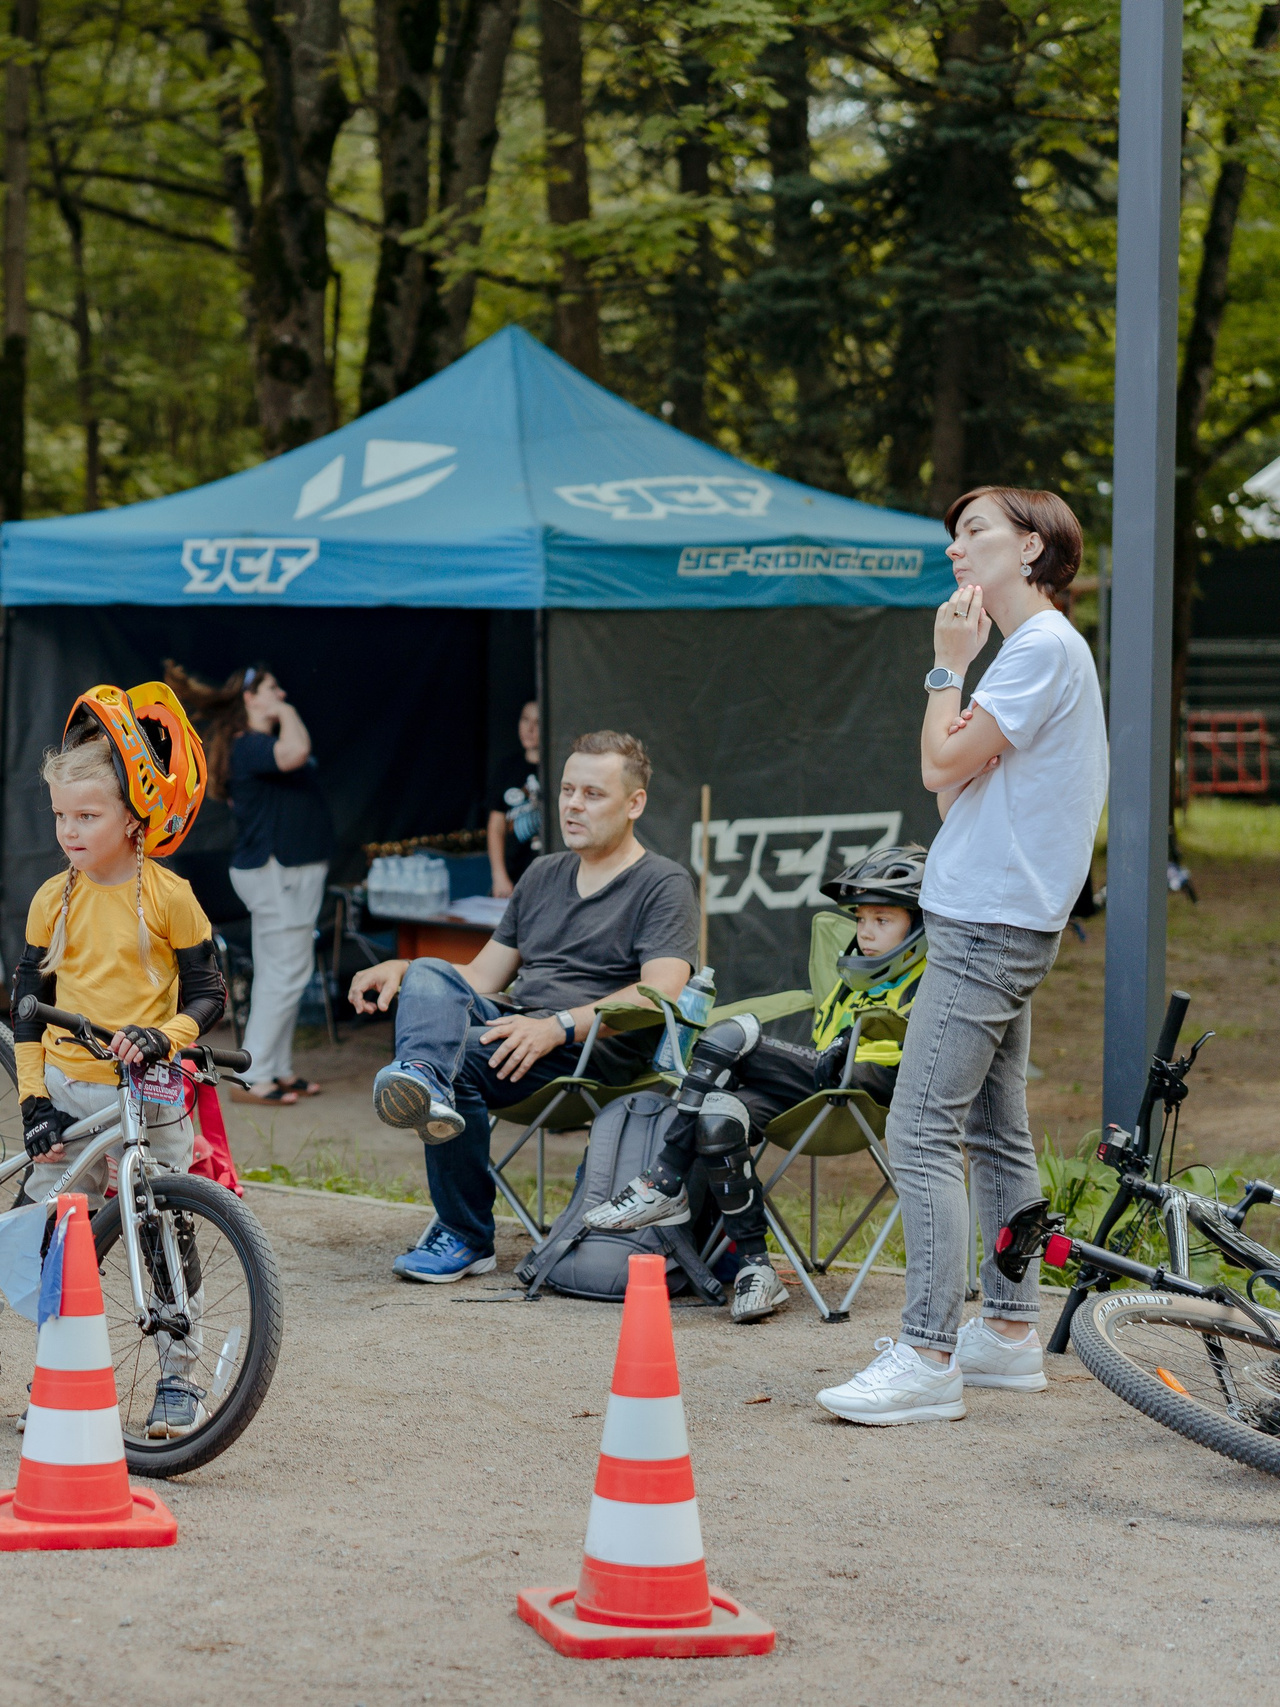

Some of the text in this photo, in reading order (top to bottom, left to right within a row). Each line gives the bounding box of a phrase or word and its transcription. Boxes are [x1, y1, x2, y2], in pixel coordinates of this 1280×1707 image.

[554, 475, 773, 520] YCF
[180, 538, 320, 593] YCF
[677, 546, 923, 578] YCF-RIDING.COM
[691, 811, 903, 914] YCF
[25, 1121, 49, 1141] JETCAT
[1102, 1299, 1121, 1317] JACK
[1121, 1295, 1169, 1306] RABBIT
